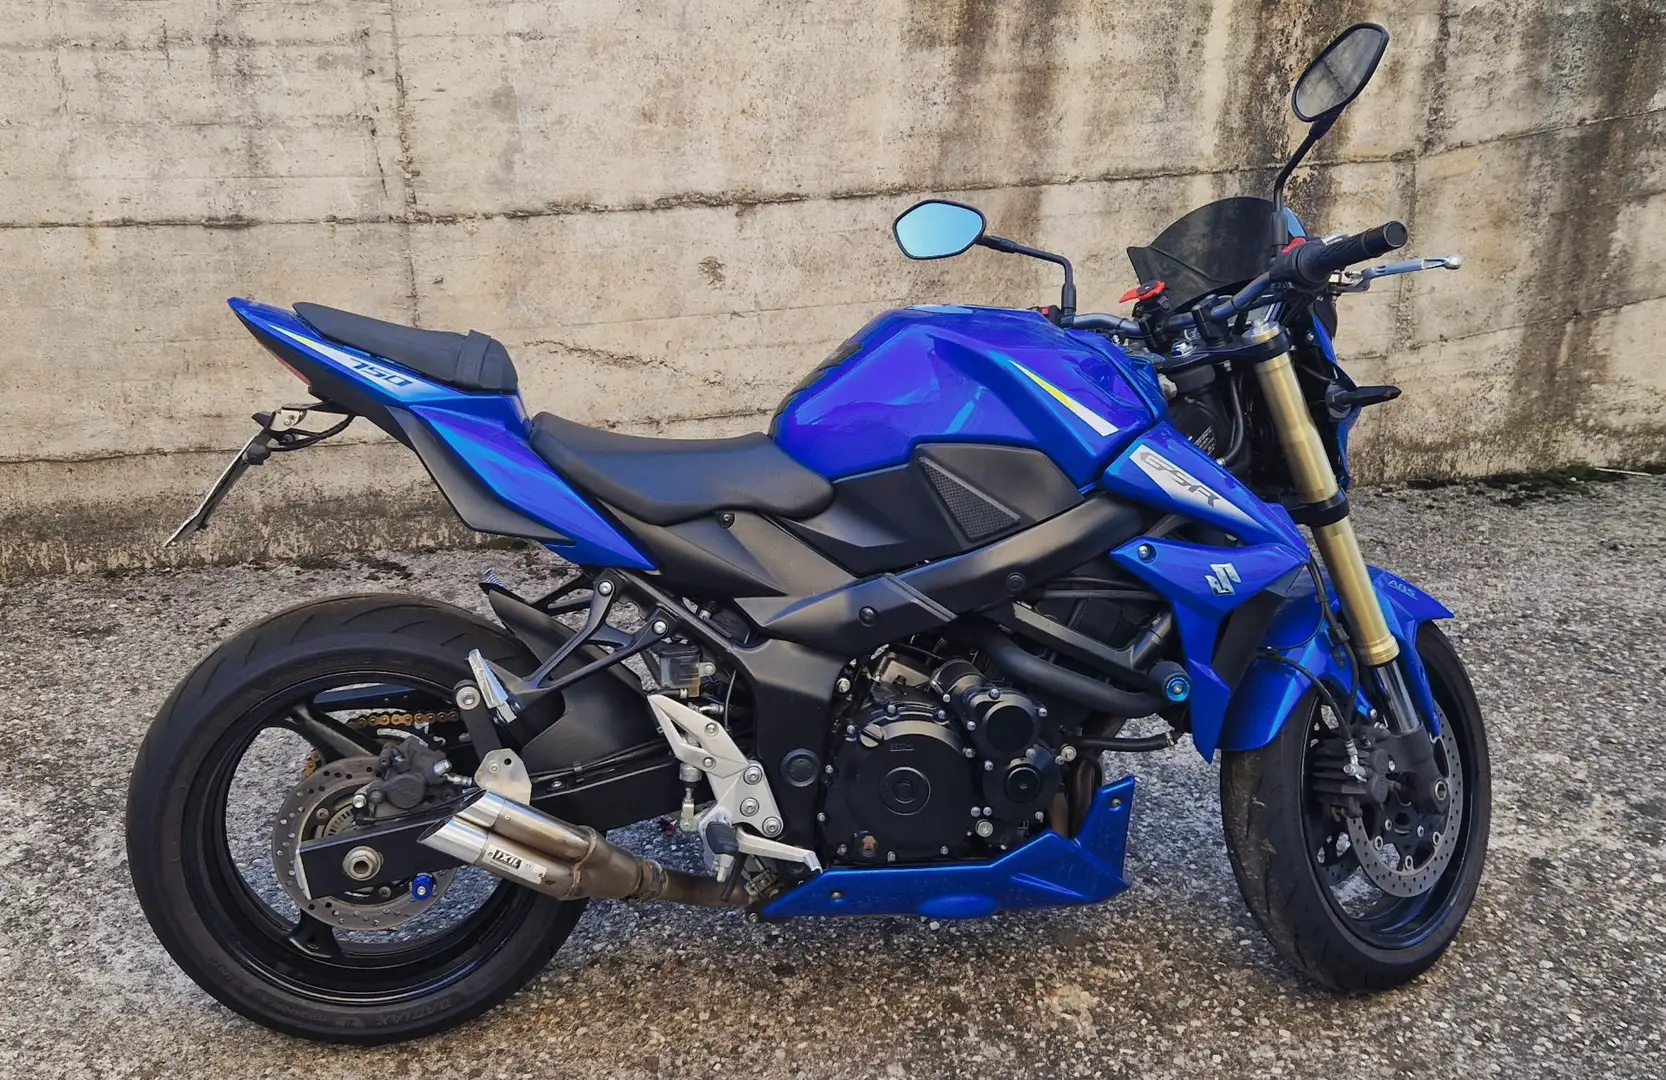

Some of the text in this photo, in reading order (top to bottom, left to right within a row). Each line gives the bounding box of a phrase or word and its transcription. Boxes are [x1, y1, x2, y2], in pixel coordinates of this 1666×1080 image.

[350, 358, 413, 387] 750
[1139, 452, 1220, 508] GSR
[1388, 580, 1416, 597] ABS
